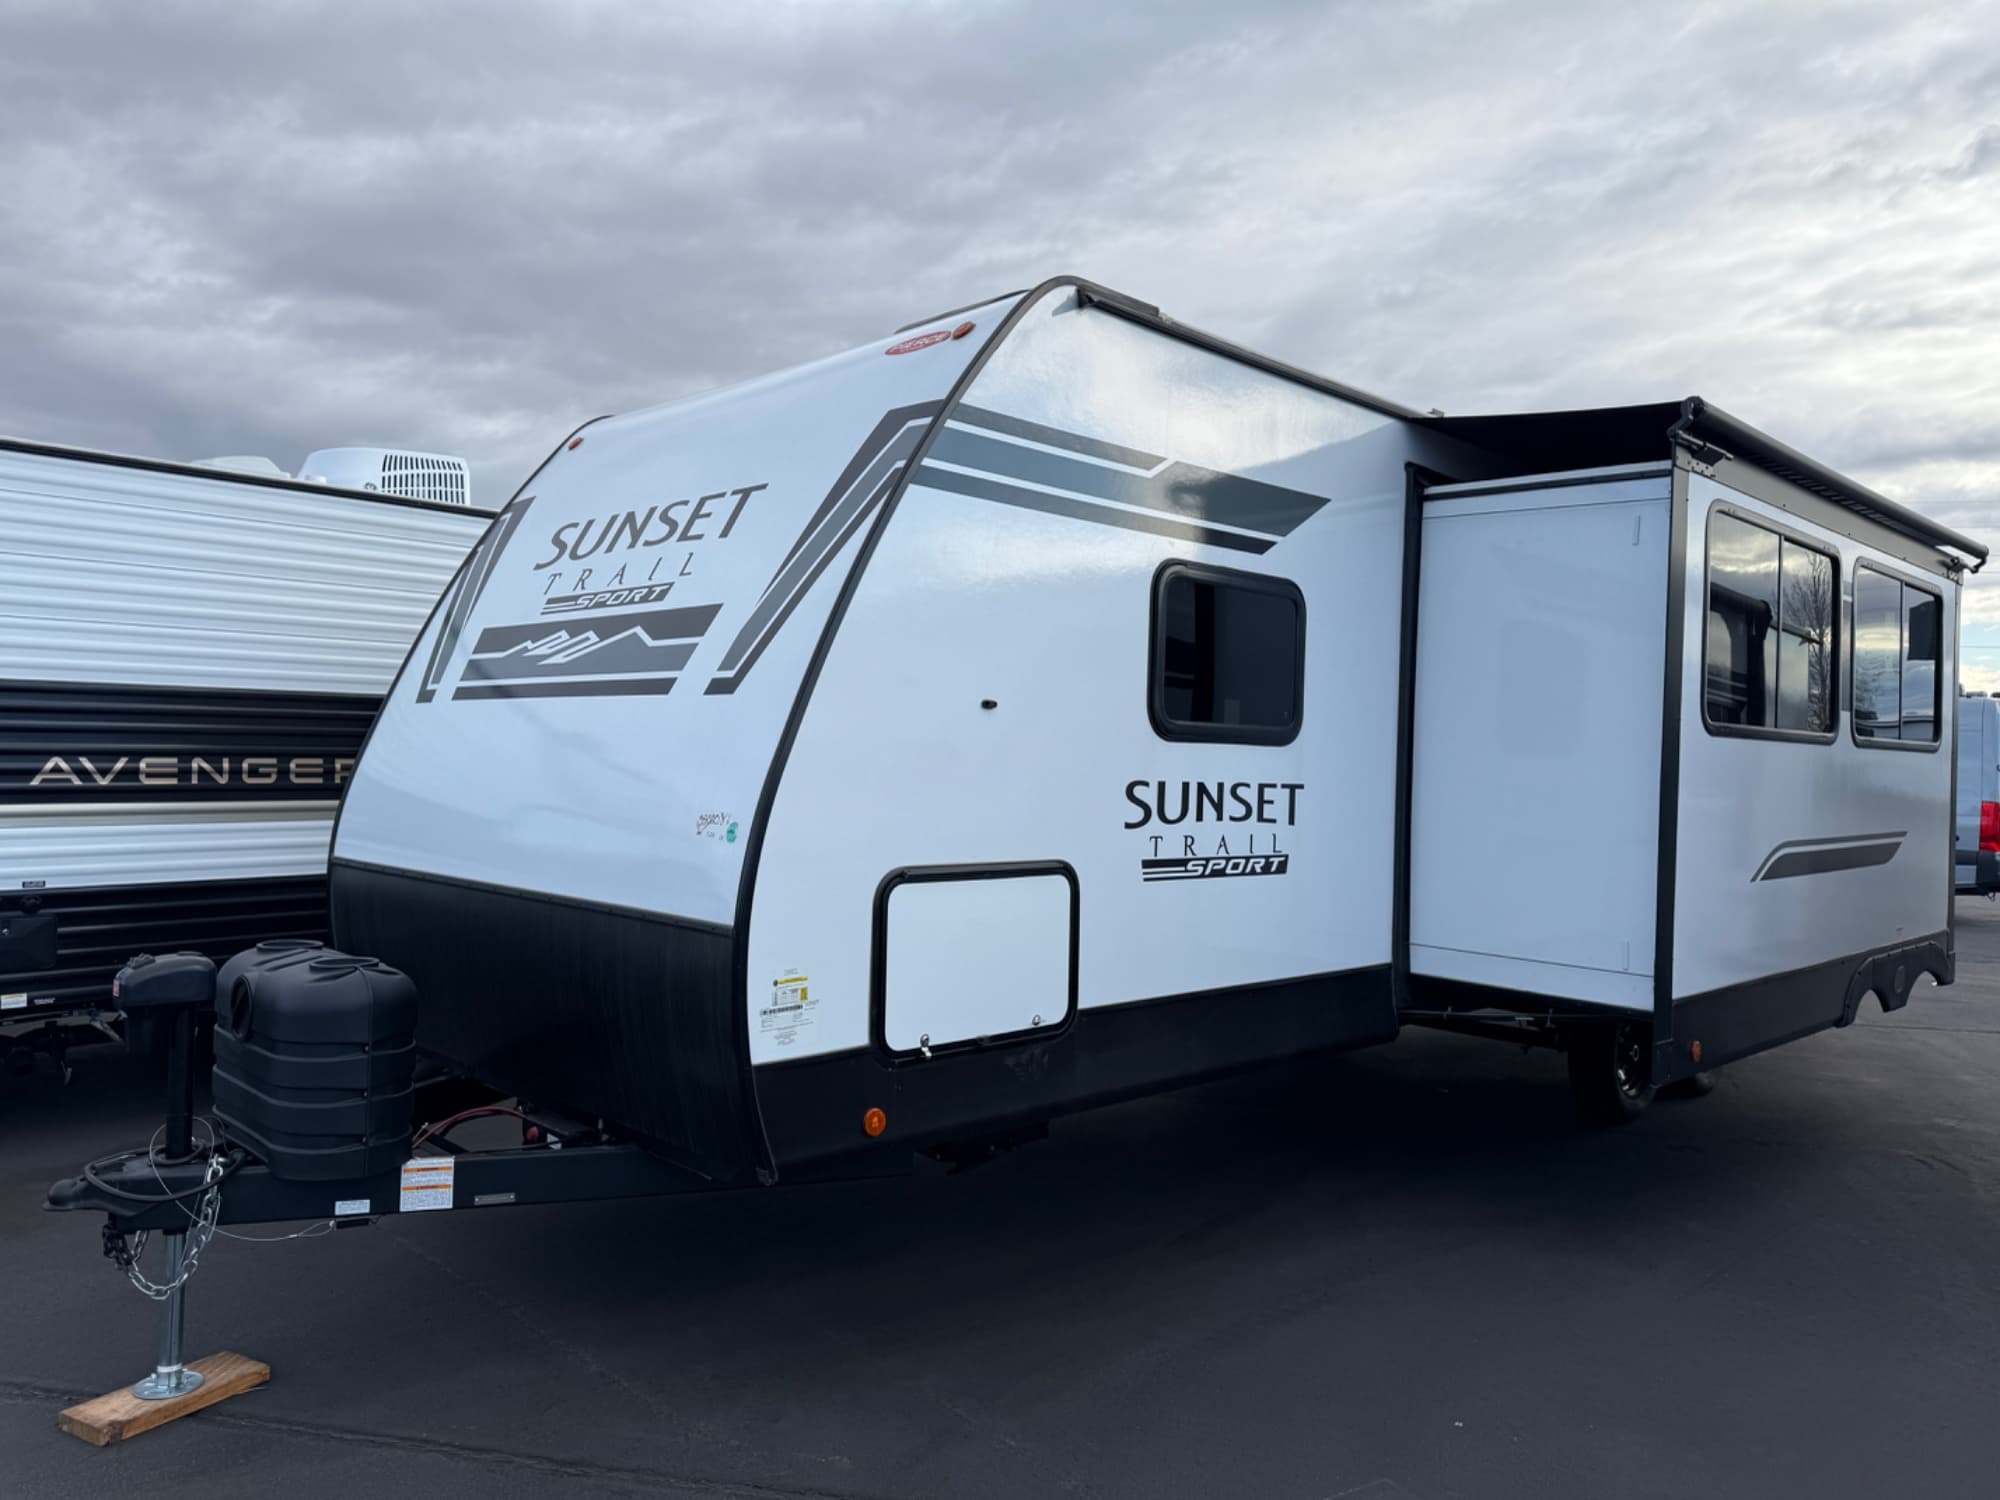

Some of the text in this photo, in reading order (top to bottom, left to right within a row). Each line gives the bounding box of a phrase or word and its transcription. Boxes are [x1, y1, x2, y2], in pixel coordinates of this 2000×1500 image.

[533, 483, 769, 571] SUNSET
[544, 552, 693, 595] TRAIL
[576, 584, 671, 608] SPORT
[1124, 779, 1305, 829] SUNSET
[1149, 833, 1282, 857] TRAIL
[1186, 856, 1286, 876] SPORT
